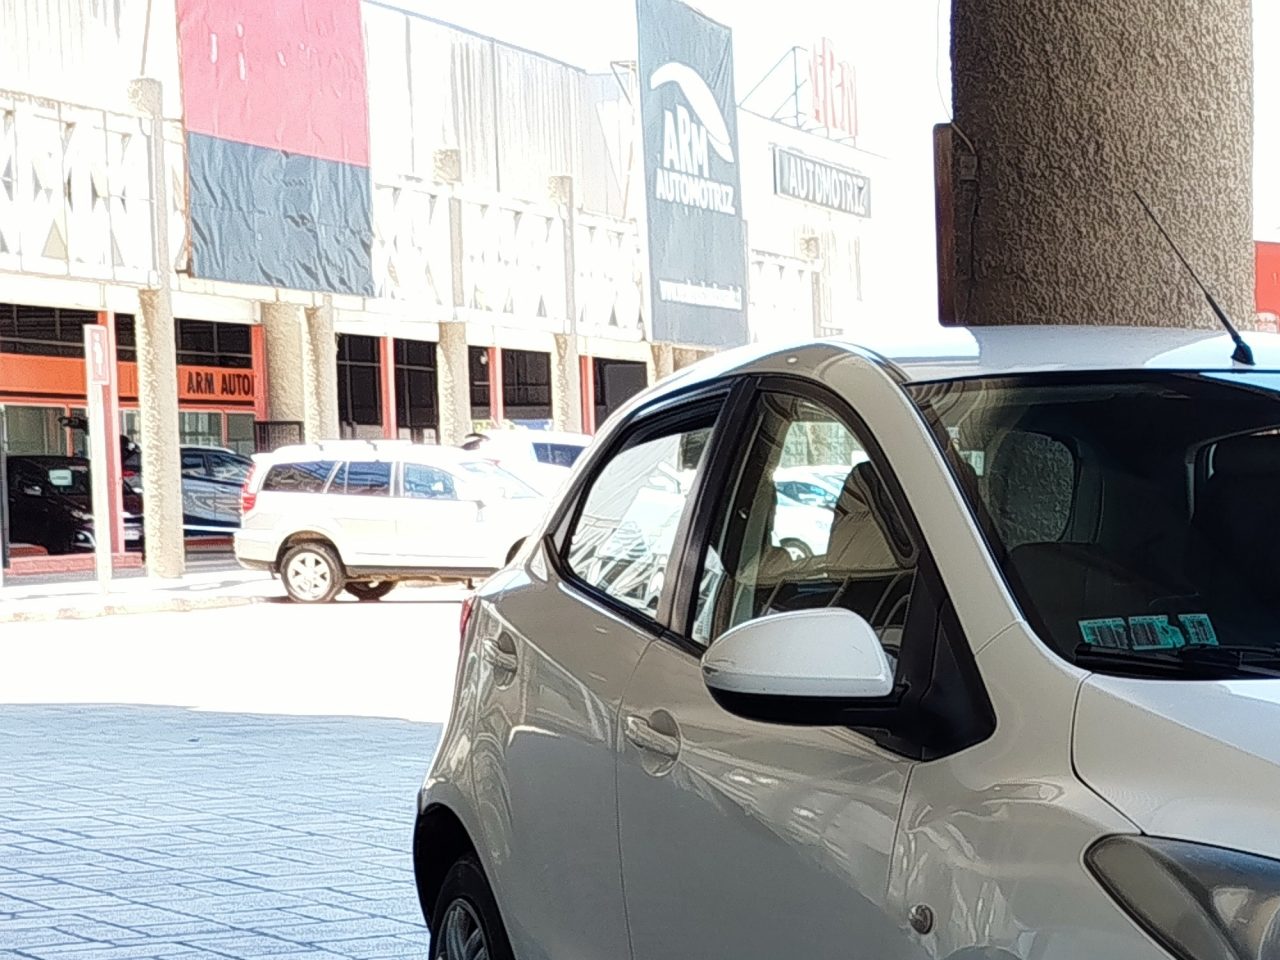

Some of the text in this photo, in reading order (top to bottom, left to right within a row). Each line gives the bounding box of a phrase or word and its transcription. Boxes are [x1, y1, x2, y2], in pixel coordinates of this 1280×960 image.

[662, 103, 710, 178] ARM
[655, 168, 735, 215] AUTOMOTRIZ
[789, 156, 867, 217] AUTOMOTRIZ
[187, 370, 255, 397] ARM AUTO
